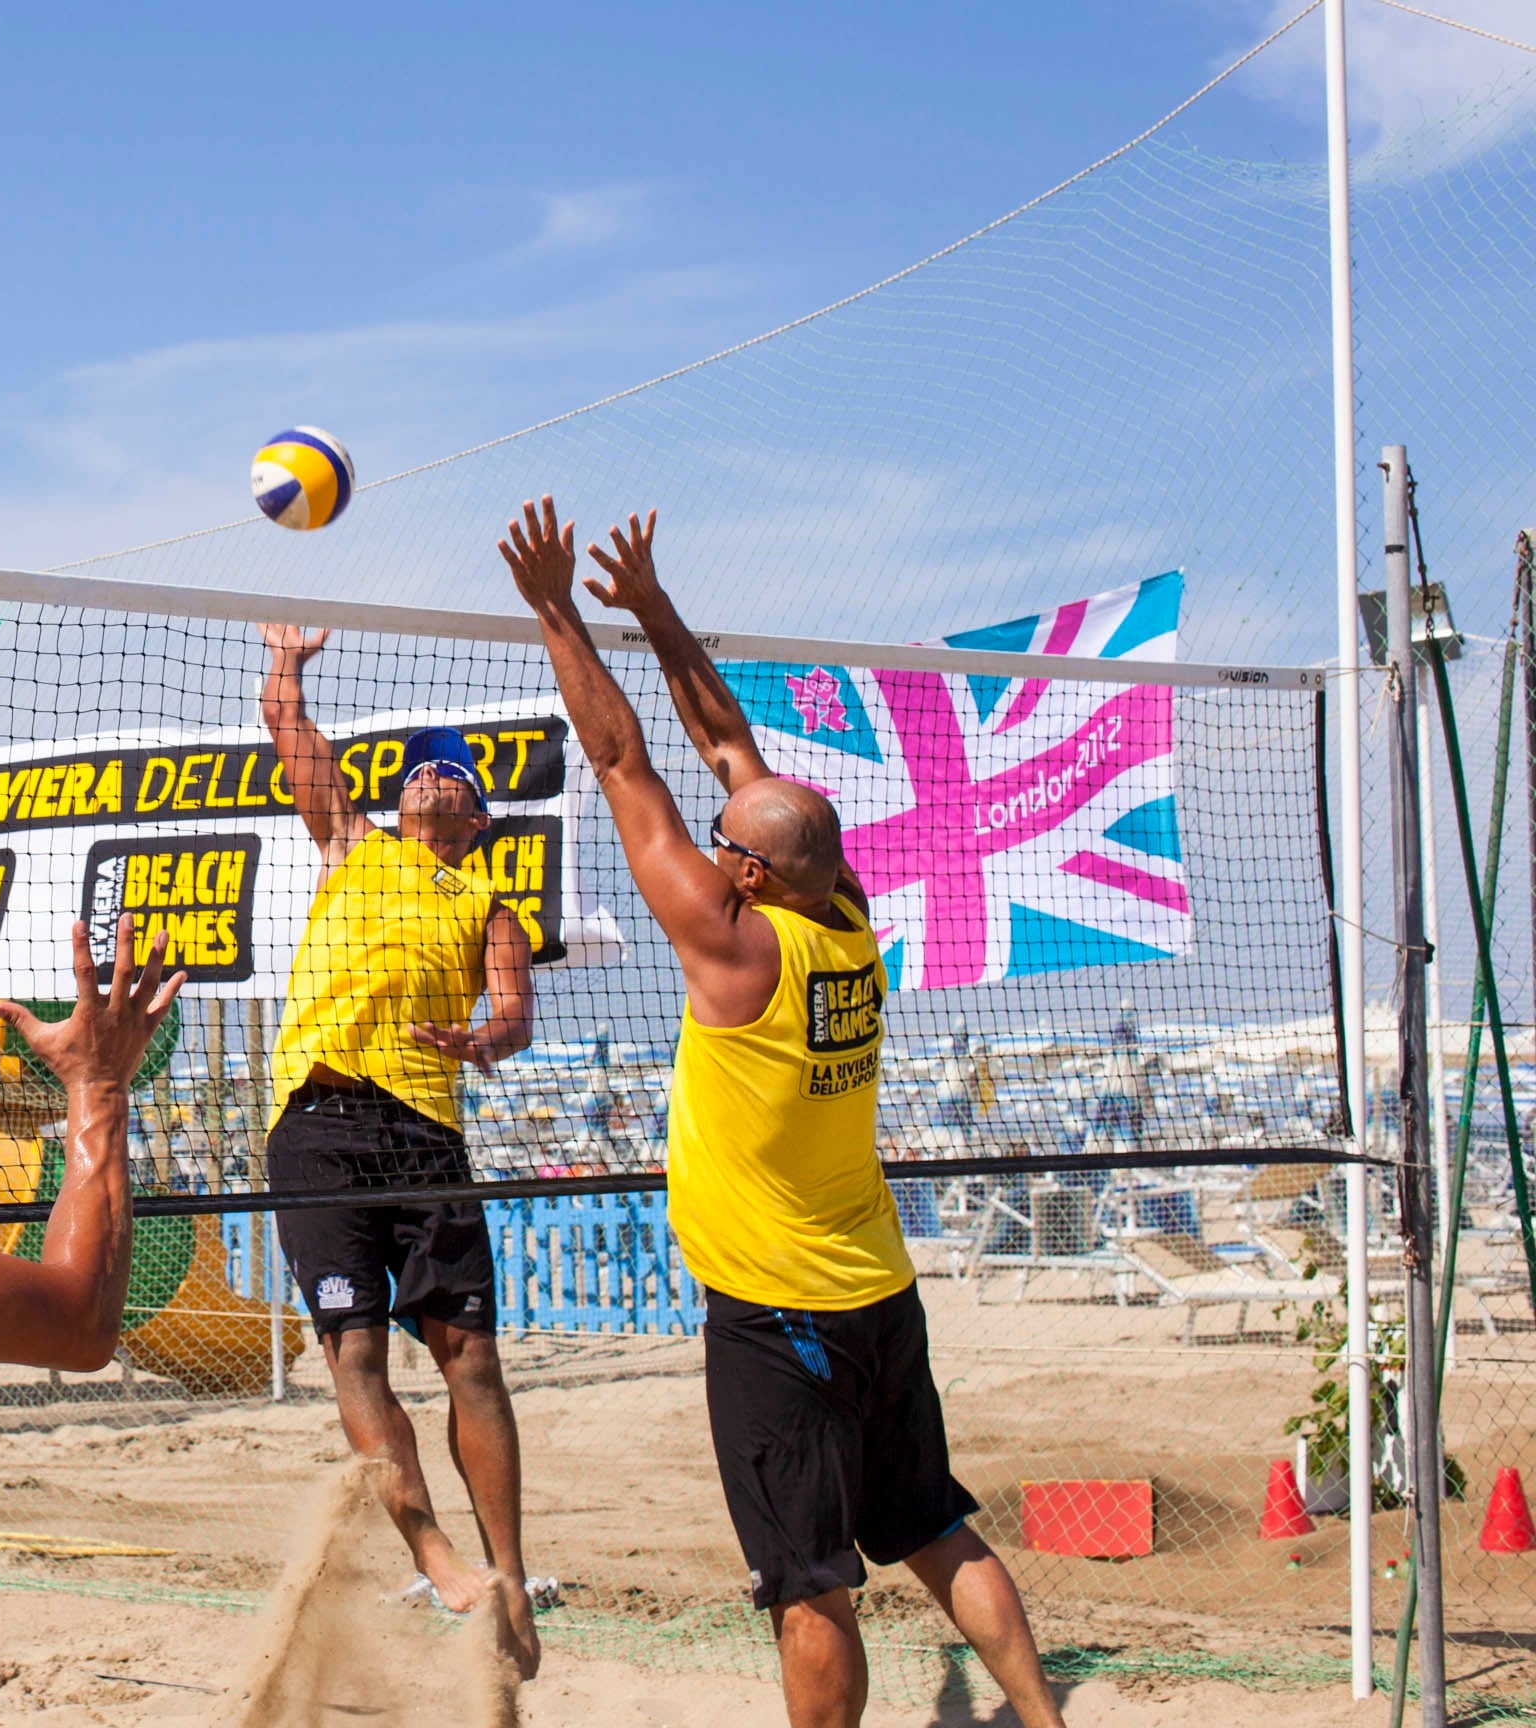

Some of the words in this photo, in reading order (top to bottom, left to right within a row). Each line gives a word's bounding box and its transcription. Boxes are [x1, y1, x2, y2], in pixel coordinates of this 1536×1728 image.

[1230, 668, 1269, 684] vision
[338, 730, 545, 801] SPRT
[974, 765, 1073, 836] London
[1075, 715, 1122, 779] 2012
[123, 850, 246, 908] BEACH
[814, 982, 824, 1043] RIVIERA
[829, 1002, 879, 1043] GAMES
[809, 1081, 848, 1096] DELLO
[811, 1064, 832, 1082] LA
